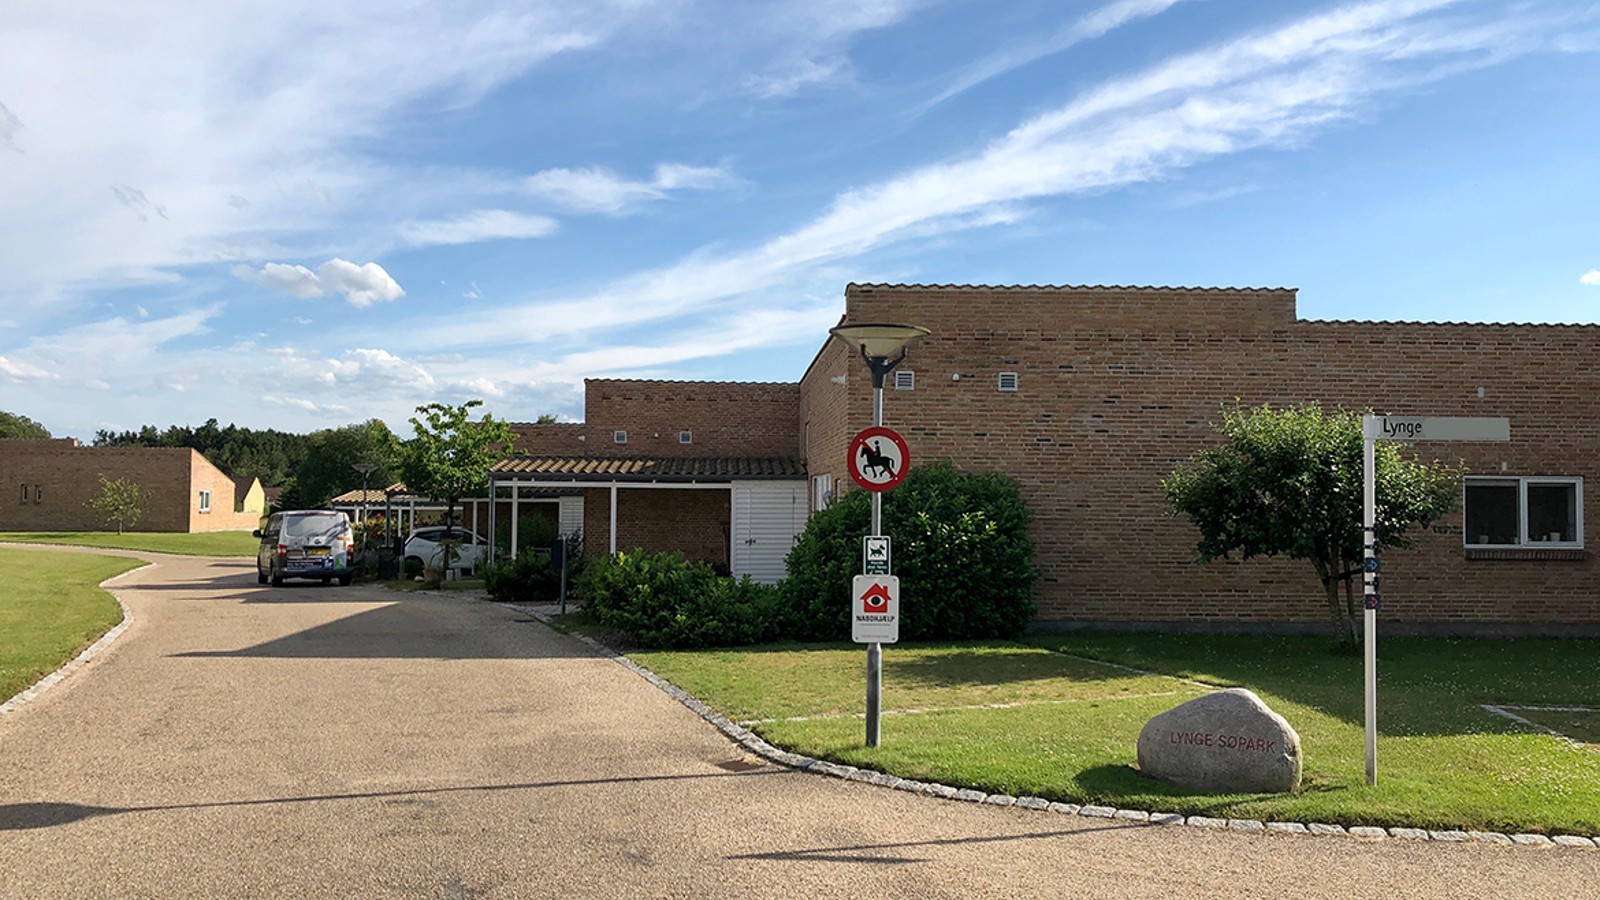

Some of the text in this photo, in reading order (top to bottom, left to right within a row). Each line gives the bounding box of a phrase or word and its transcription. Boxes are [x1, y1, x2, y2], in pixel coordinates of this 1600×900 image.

[1383, 418, 1422, 438] Lynge
[1170, 731, 1275, 753] LYNGE SØPARK
